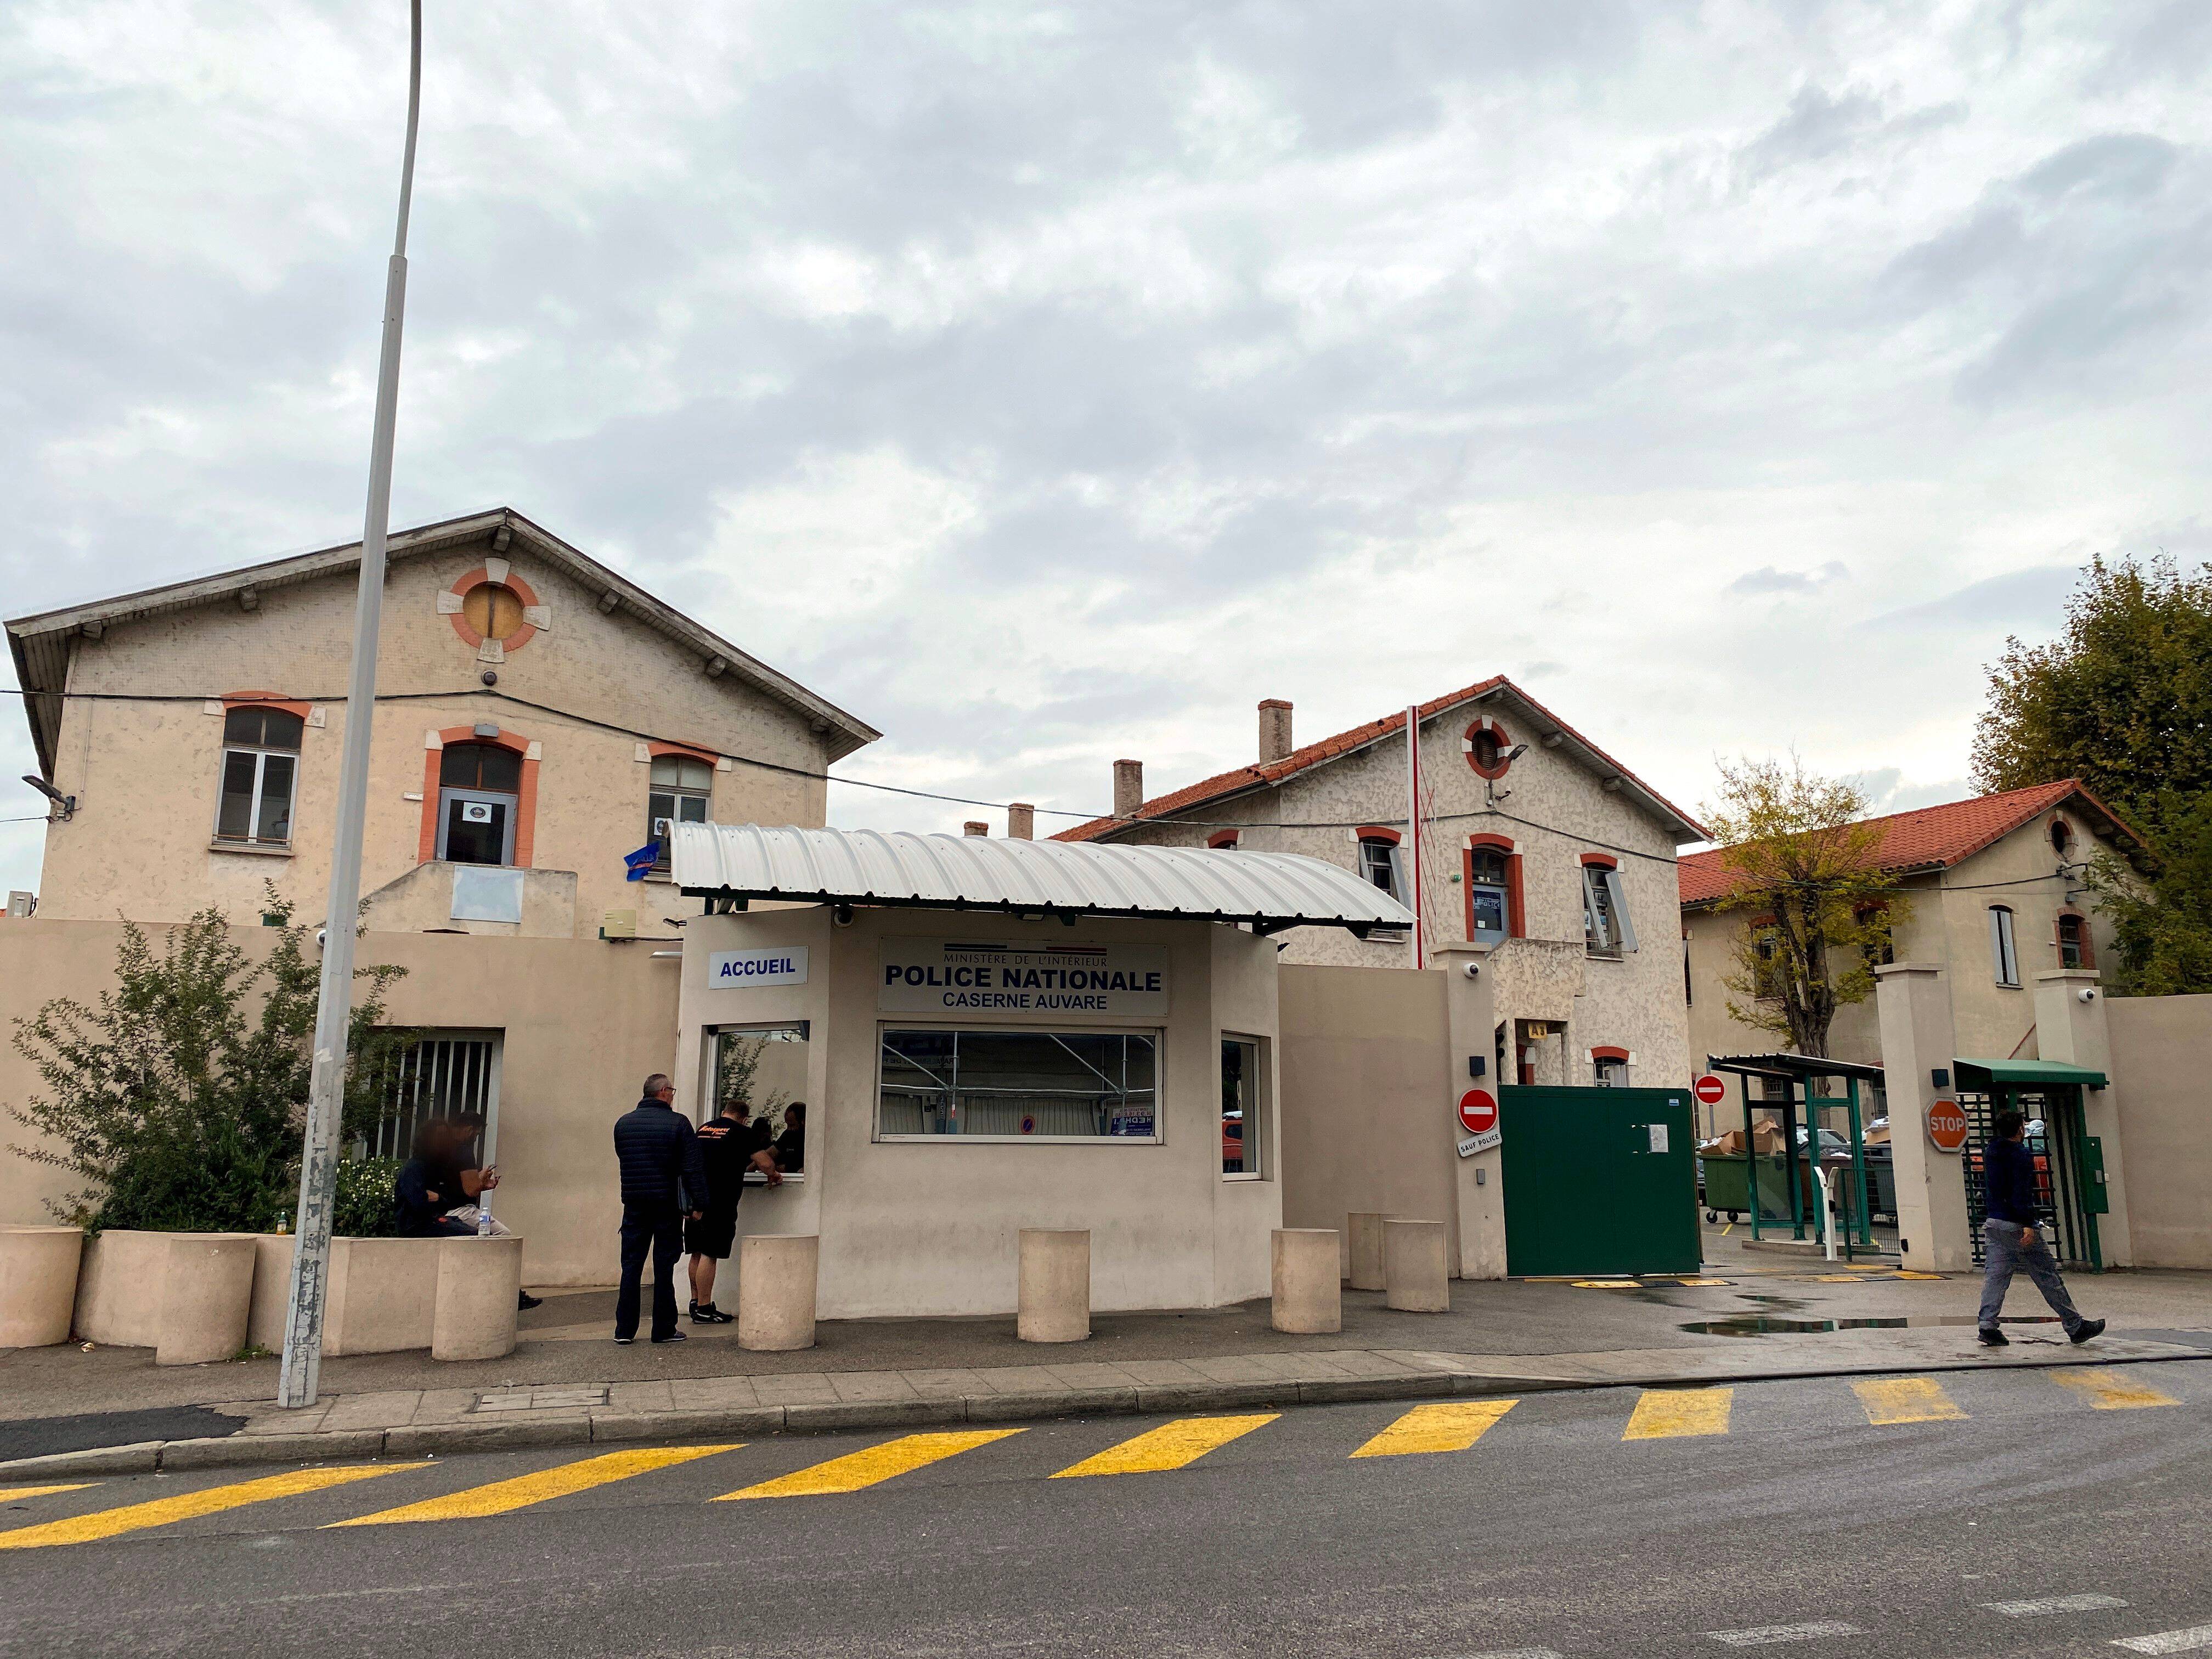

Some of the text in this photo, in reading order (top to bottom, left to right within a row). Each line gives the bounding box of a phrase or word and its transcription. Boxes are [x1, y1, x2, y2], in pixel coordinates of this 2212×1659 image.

[720, 958, 795, 977] ACCUEIL
[944, 953, 1107, 967] MINISTÈRE DE L'INTÉRIEUR
[885, 965, 1161, 992] POLICE NATIONALE
[943, 992, 1107, 1009] CASERNE AUVARE
[1931, 1116, 1965, 1132] STOP
[1460, 1133, 1499, 1152] SAUF POLICE
